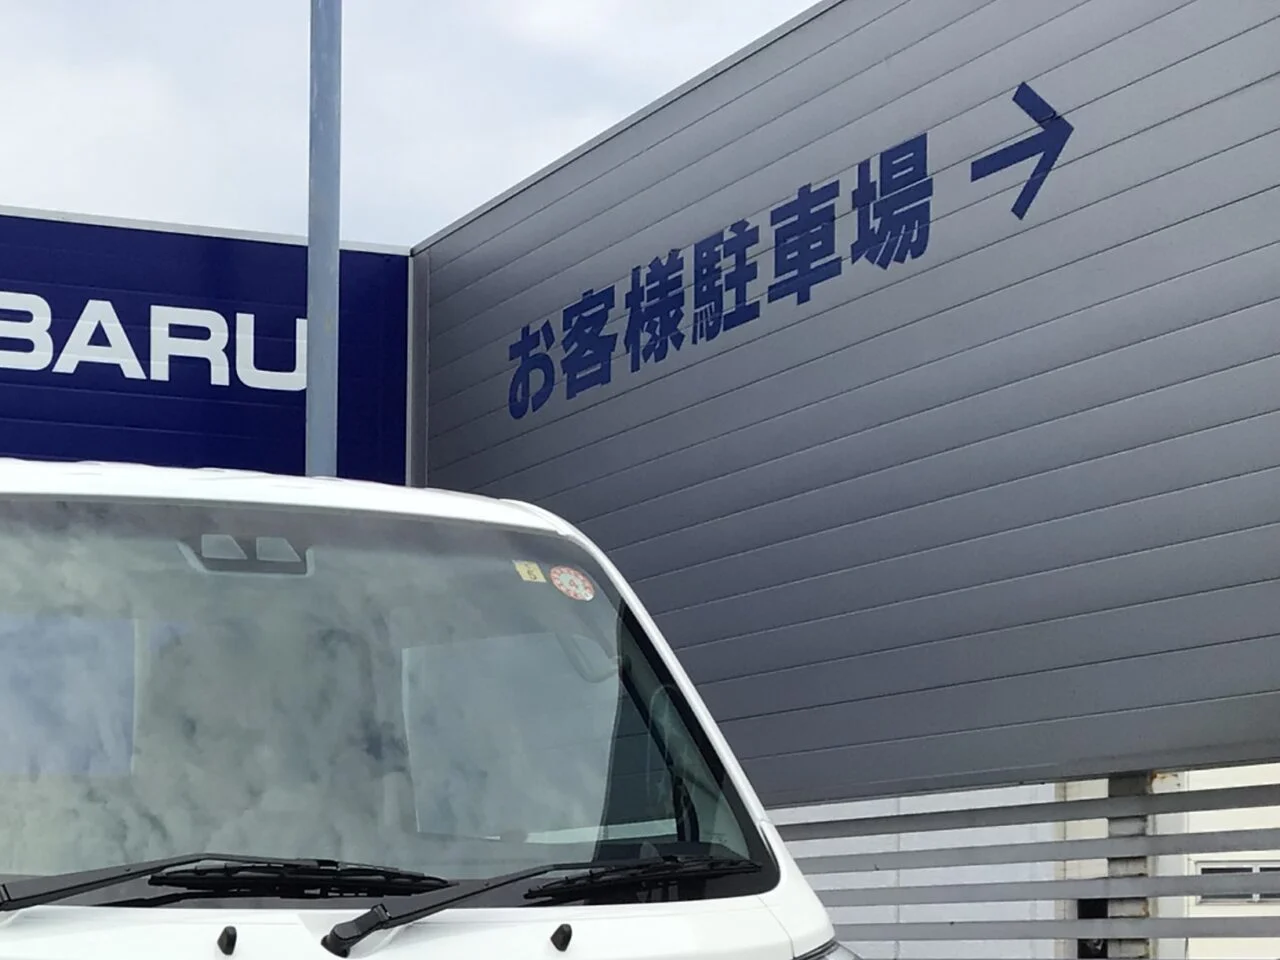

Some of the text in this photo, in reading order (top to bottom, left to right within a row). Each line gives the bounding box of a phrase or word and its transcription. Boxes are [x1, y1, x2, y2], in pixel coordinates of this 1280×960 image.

[507, 132, 934, 420] お客様駐車場
